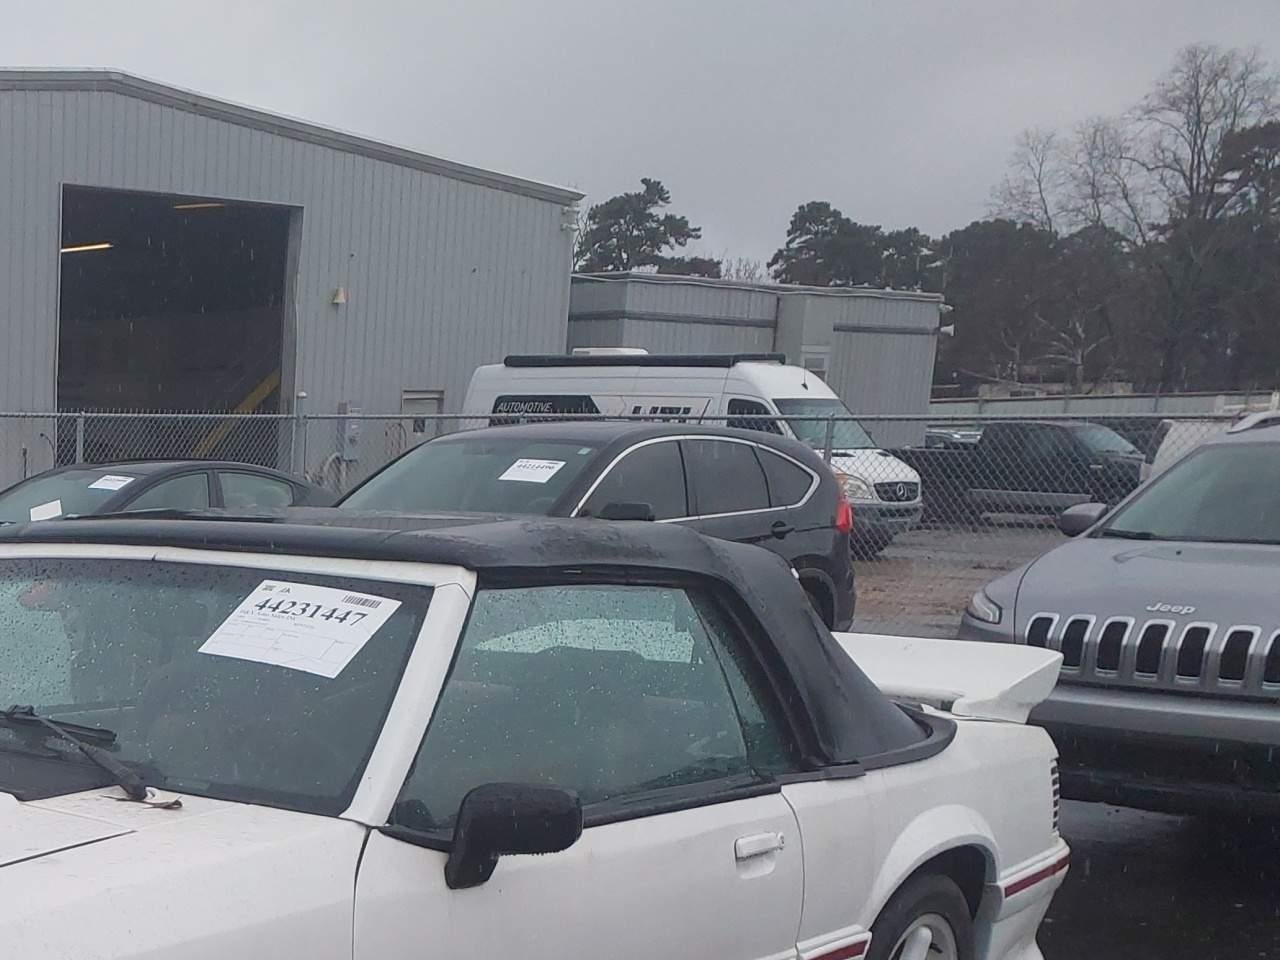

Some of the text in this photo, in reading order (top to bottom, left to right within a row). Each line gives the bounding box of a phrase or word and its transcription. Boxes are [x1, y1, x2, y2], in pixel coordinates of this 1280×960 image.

[496, 401, 553, 414] AUTOMOTIVE
[254, 597, 369, 627] 44231447
[1146, 602, 1197, 615] Jeep
